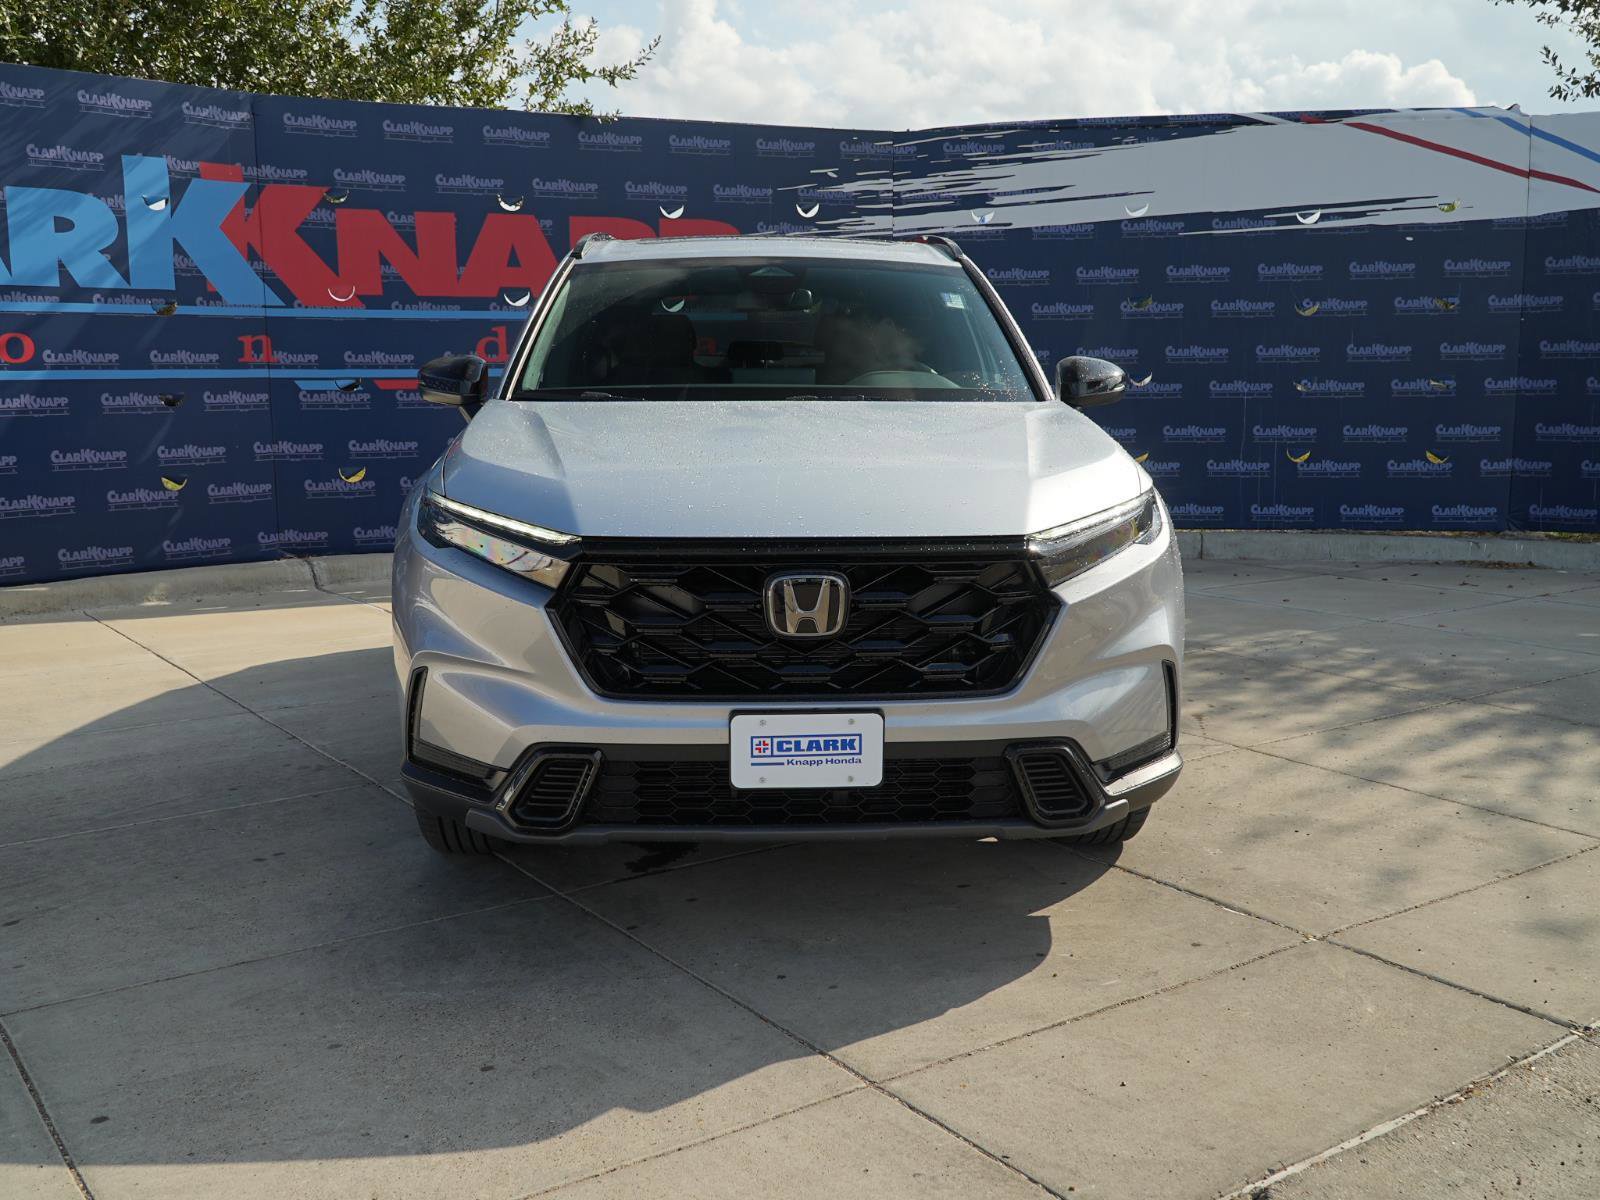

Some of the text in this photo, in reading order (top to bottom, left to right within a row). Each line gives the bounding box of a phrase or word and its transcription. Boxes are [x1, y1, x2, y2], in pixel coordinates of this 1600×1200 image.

[0, 155, 285, 306] RK
[238, 334, 281, 363] n
[475, 325, 509, 362] d
[777, 739, 857, 752] CLARK
[787, 757, 861, 766] Knapp Honda
